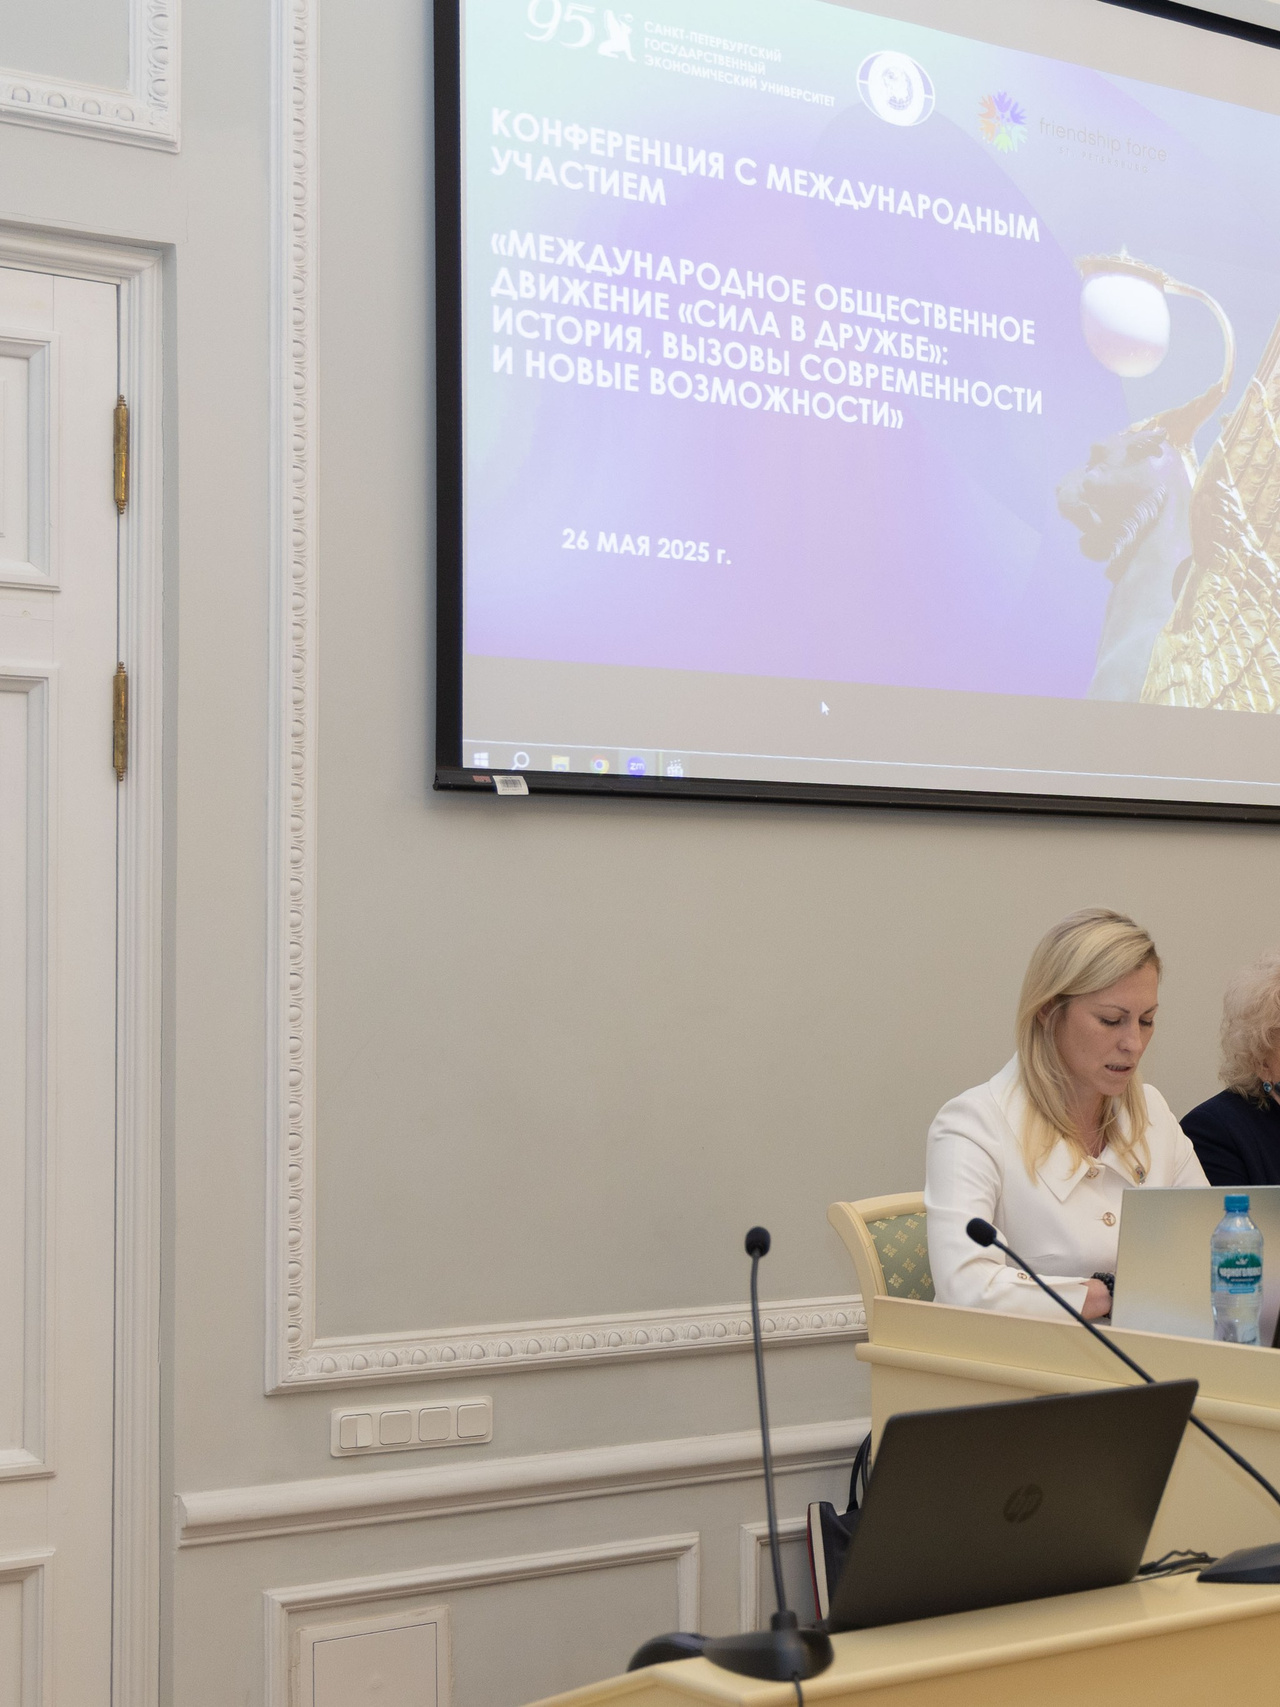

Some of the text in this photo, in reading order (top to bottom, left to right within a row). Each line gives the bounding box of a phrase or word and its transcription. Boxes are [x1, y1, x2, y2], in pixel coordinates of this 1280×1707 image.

[523, 0, 597, 49] 95
[643, 21, 782, 63] САНКТ-ПЕТЕРБУРГСКИЙ
[643, 37, 767, 76] ГОСУДАРСТВЕННЫЙ
[643, 54, 836, 107] ЭКОНОМИЧЕСКИЙ УНИВЕРСИТЕТ
[1039, 117, 1169, 162] friendship force
[490, 146, 667, 206] УЧАСТИЕМ
[491, 107, 1041, 243] КОНФЕРЕНЦИЯ С МЕЖДУНАРОДНЫМ
[491, 229, 1036, 345] «МЕЖДУНАРОДНОЕ ОБЩЕСТВЕННОЕ
[490, 267, 949, 366] ДВИЖЕНИЕ «СИЛА В ДРУЖБЕ»:
[491, 304, 1043, 415] ИСТОРИЯ, ВЫЗОВЫ СОВРЕМЕННОСТИ
[492, 344, 904, 429] И НОВЫЕ ВОЗМОЖНОСТИ»
[561, 527, 732, 565] 26 МАЯ 2025 г.
